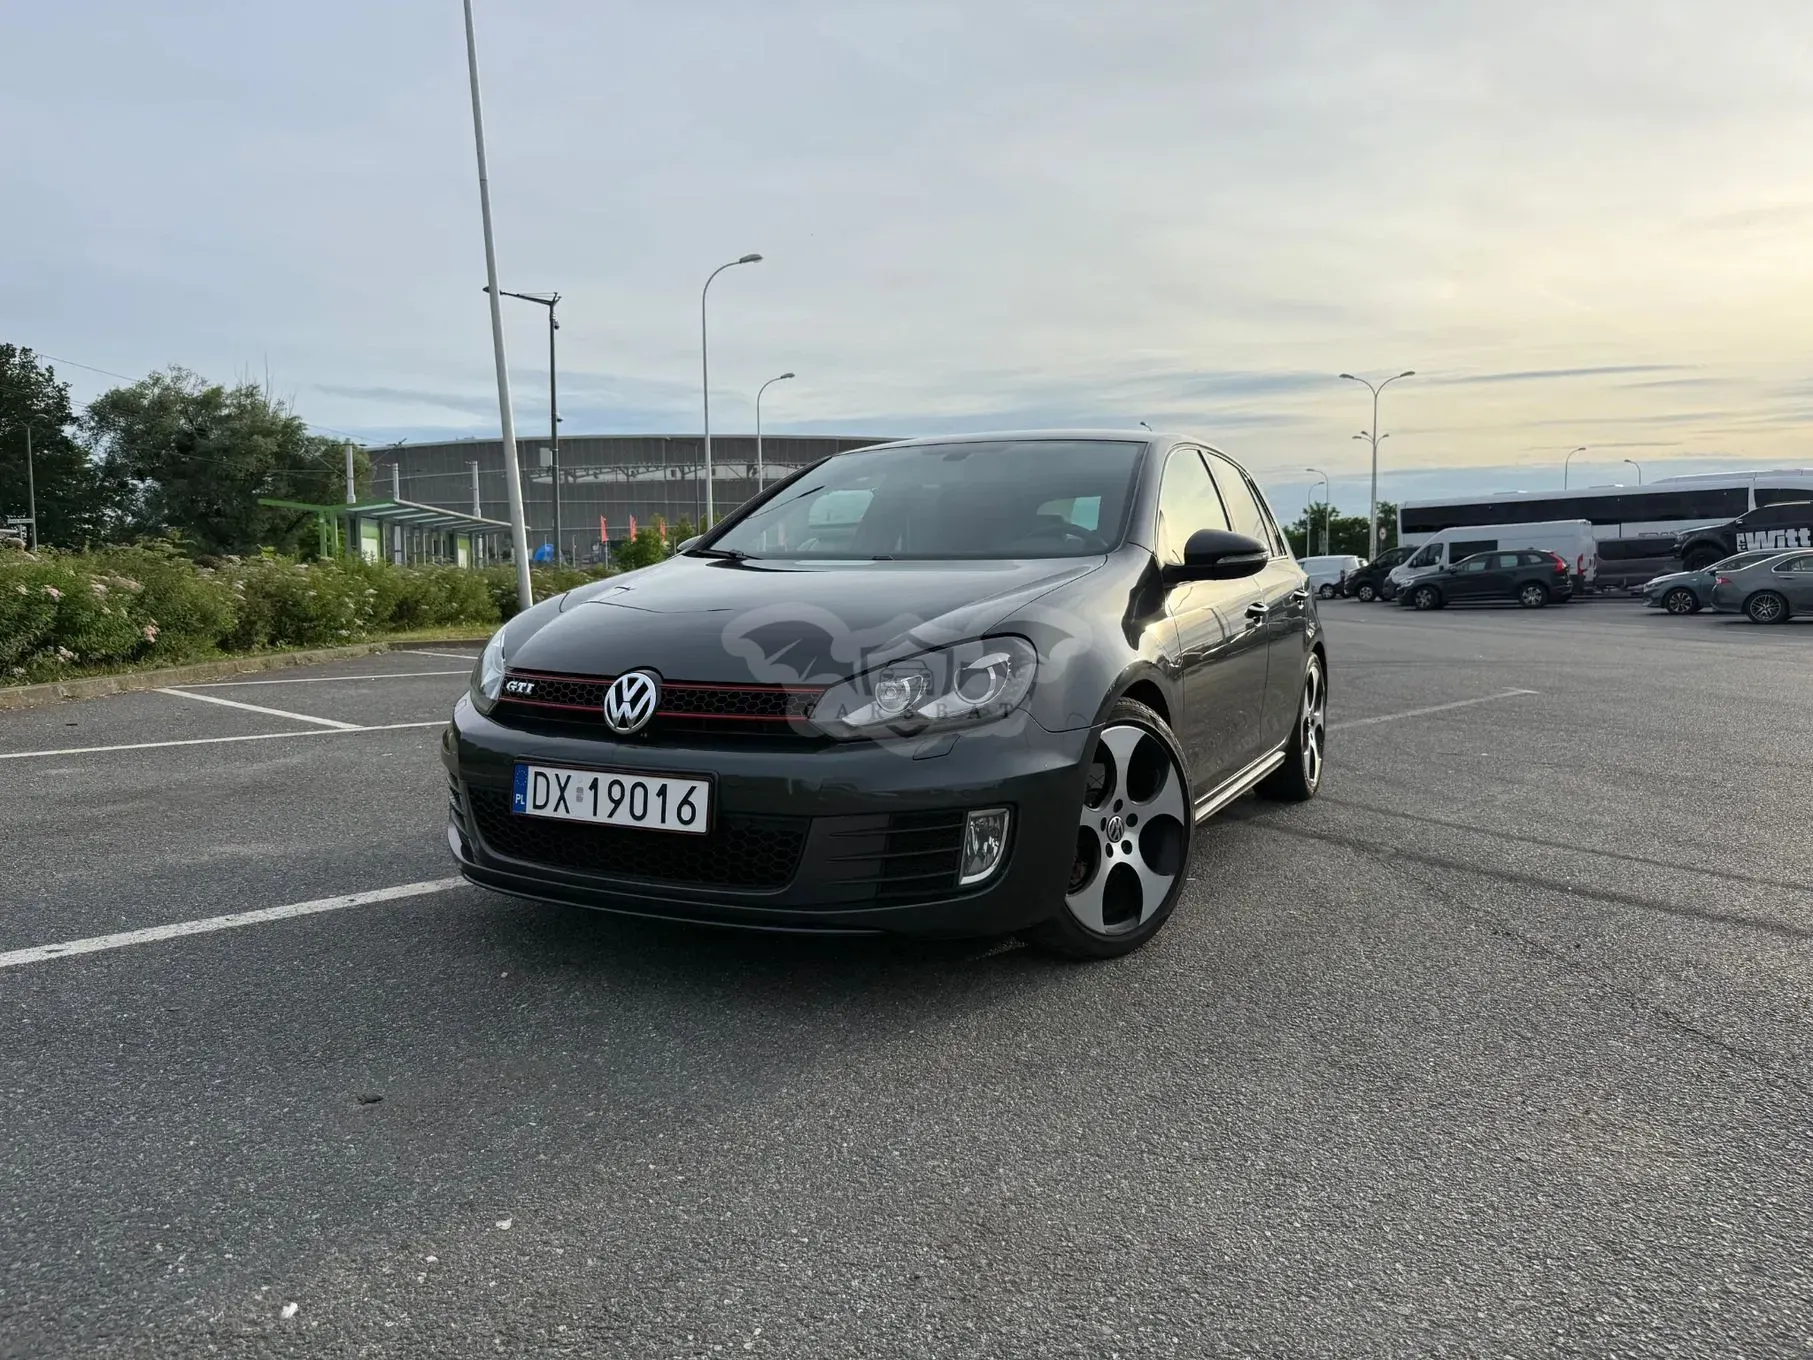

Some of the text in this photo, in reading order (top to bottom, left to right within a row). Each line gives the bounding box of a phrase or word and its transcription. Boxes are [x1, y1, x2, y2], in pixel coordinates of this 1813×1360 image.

[1745, 528, 1811, 549] Witt
[506, 681, 535, 694] GTI
[604, 672, 657, 734] VW
[515, 793, 526, 805] PL
[532, 771, 697, 826] DX 19016
